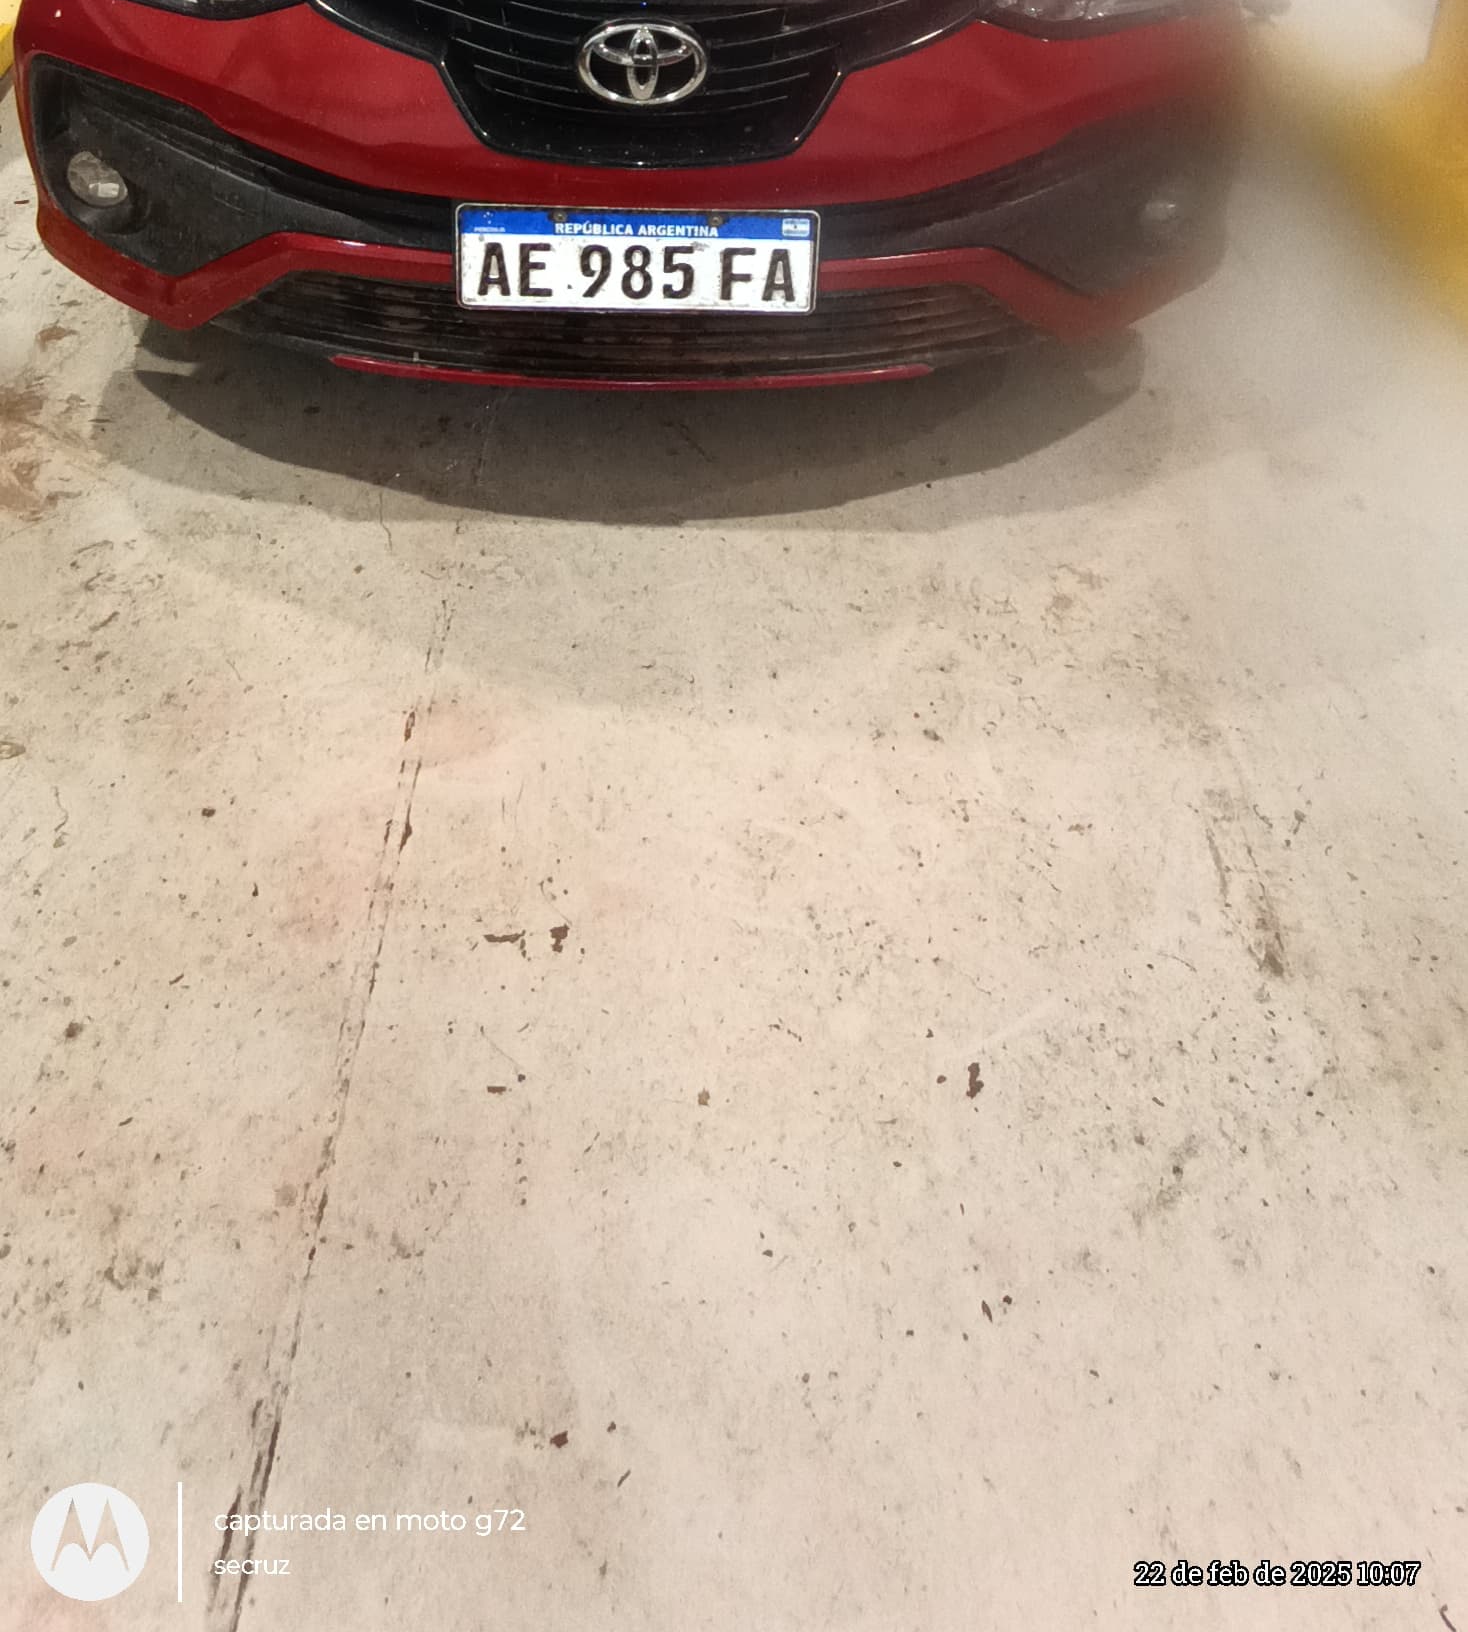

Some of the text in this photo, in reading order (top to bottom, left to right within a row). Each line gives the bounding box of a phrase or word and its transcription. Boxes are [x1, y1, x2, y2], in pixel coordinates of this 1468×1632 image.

[555, 221, 719, 238] REPÚBLICA ARGENTINA
[478, 242, 796, 302] AE 985 FA
